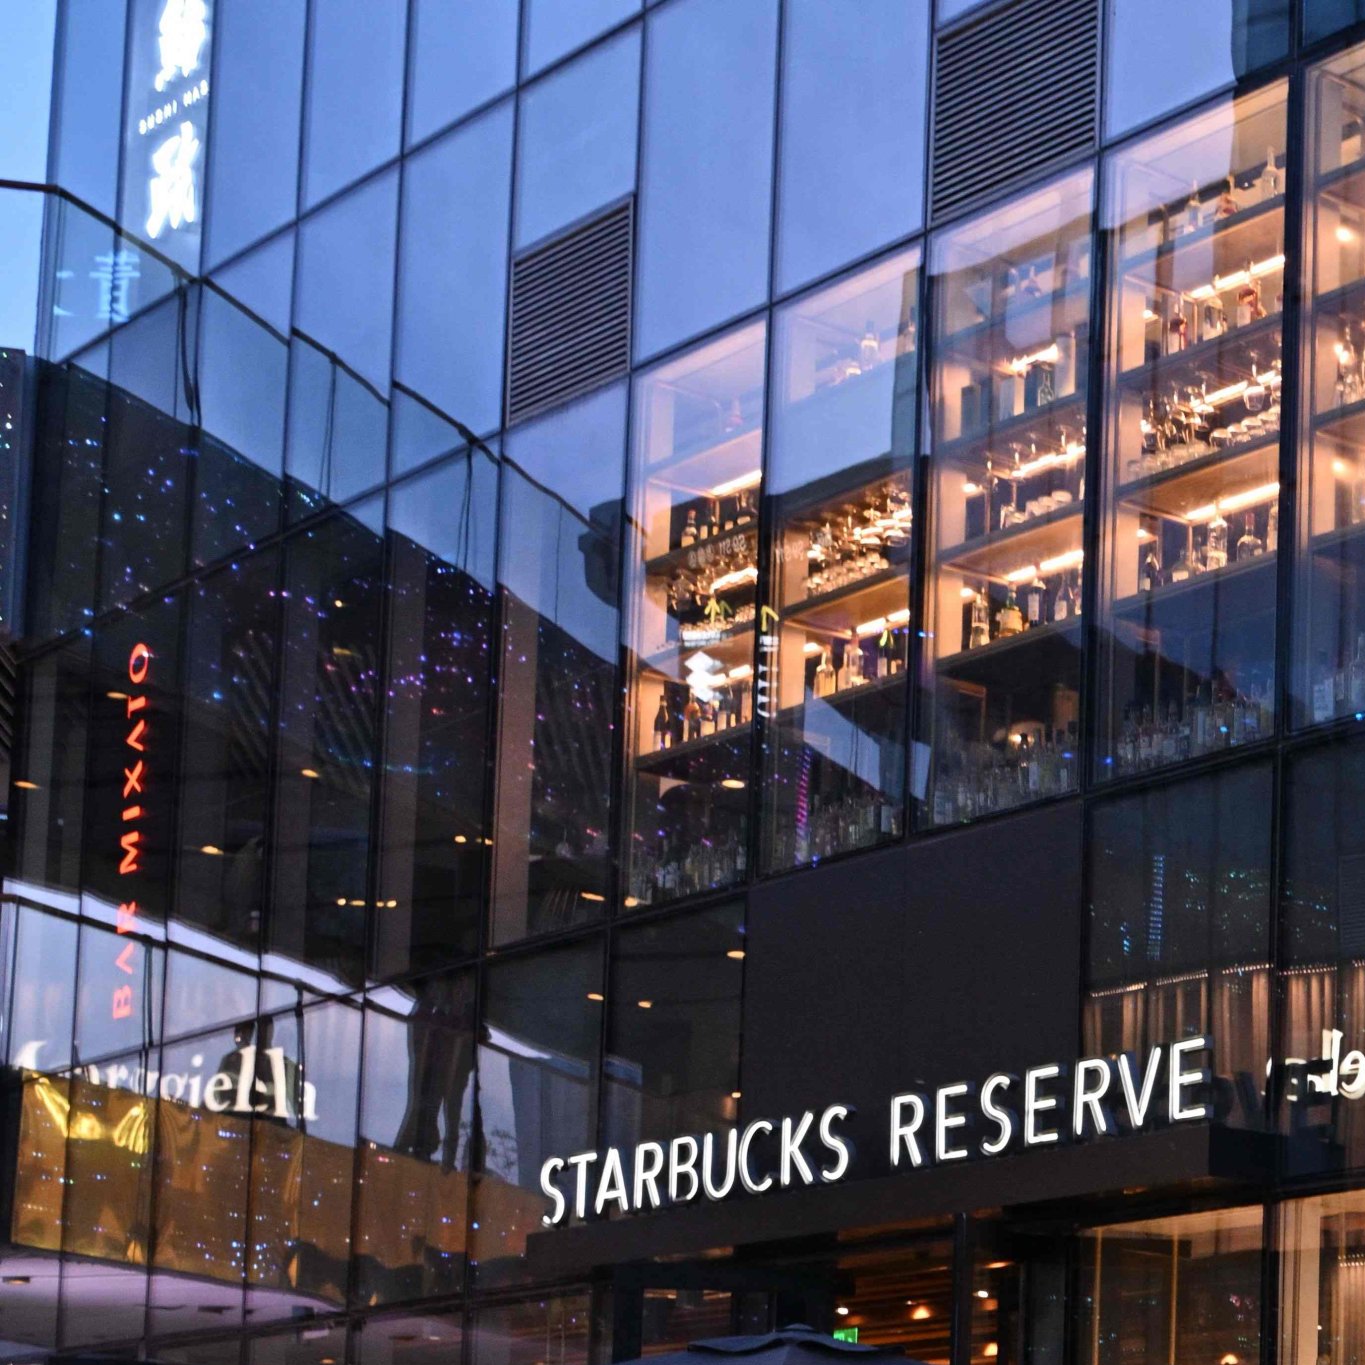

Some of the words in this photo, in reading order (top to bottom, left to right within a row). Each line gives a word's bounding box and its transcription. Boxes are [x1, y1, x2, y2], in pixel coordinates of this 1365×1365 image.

[118, 642, 149, 875] MIXATO
[112, 900, 137, 1020] BAR
[540, 1105, 850, 1228] STARBUCKS
[889, 1036, 1208, 1167] RESERVE
